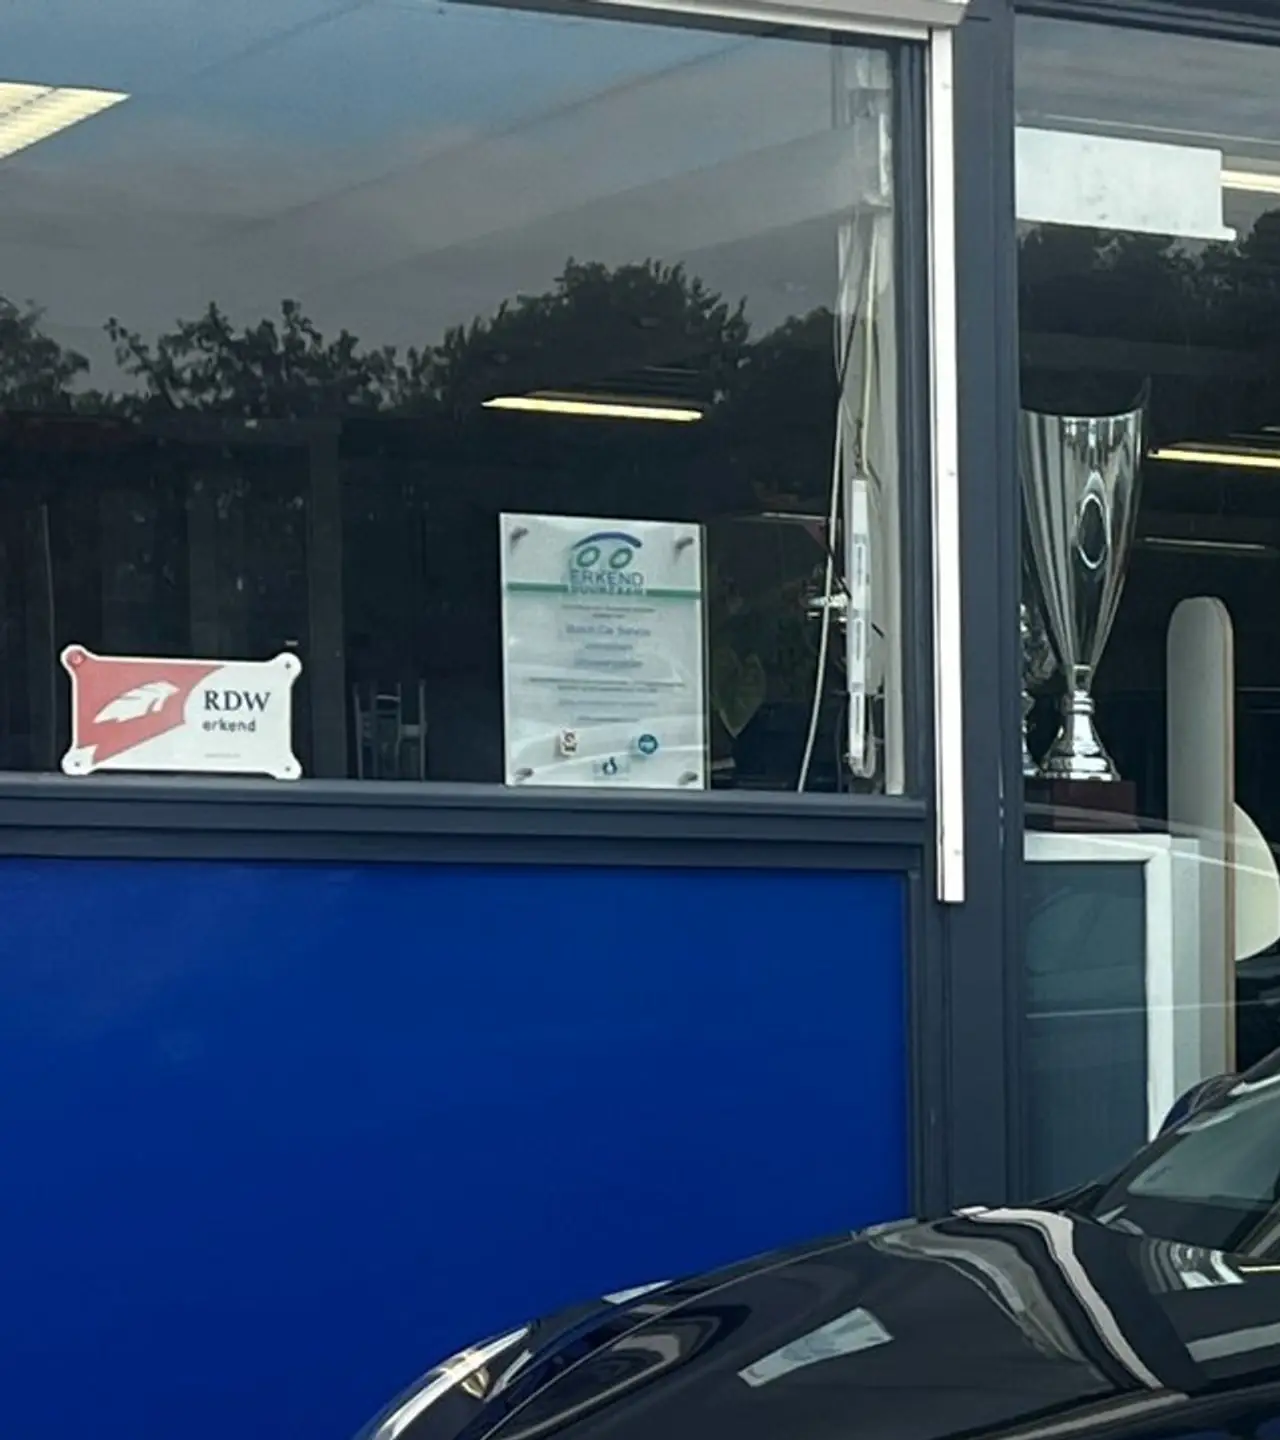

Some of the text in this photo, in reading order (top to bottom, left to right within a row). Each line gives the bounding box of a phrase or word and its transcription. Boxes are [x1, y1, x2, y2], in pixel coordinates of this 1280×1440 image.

[571, 570, 644, 586] ERKEND
[203, 690, 272, 712] RDW
[202, 718, 257, 732] erkend
